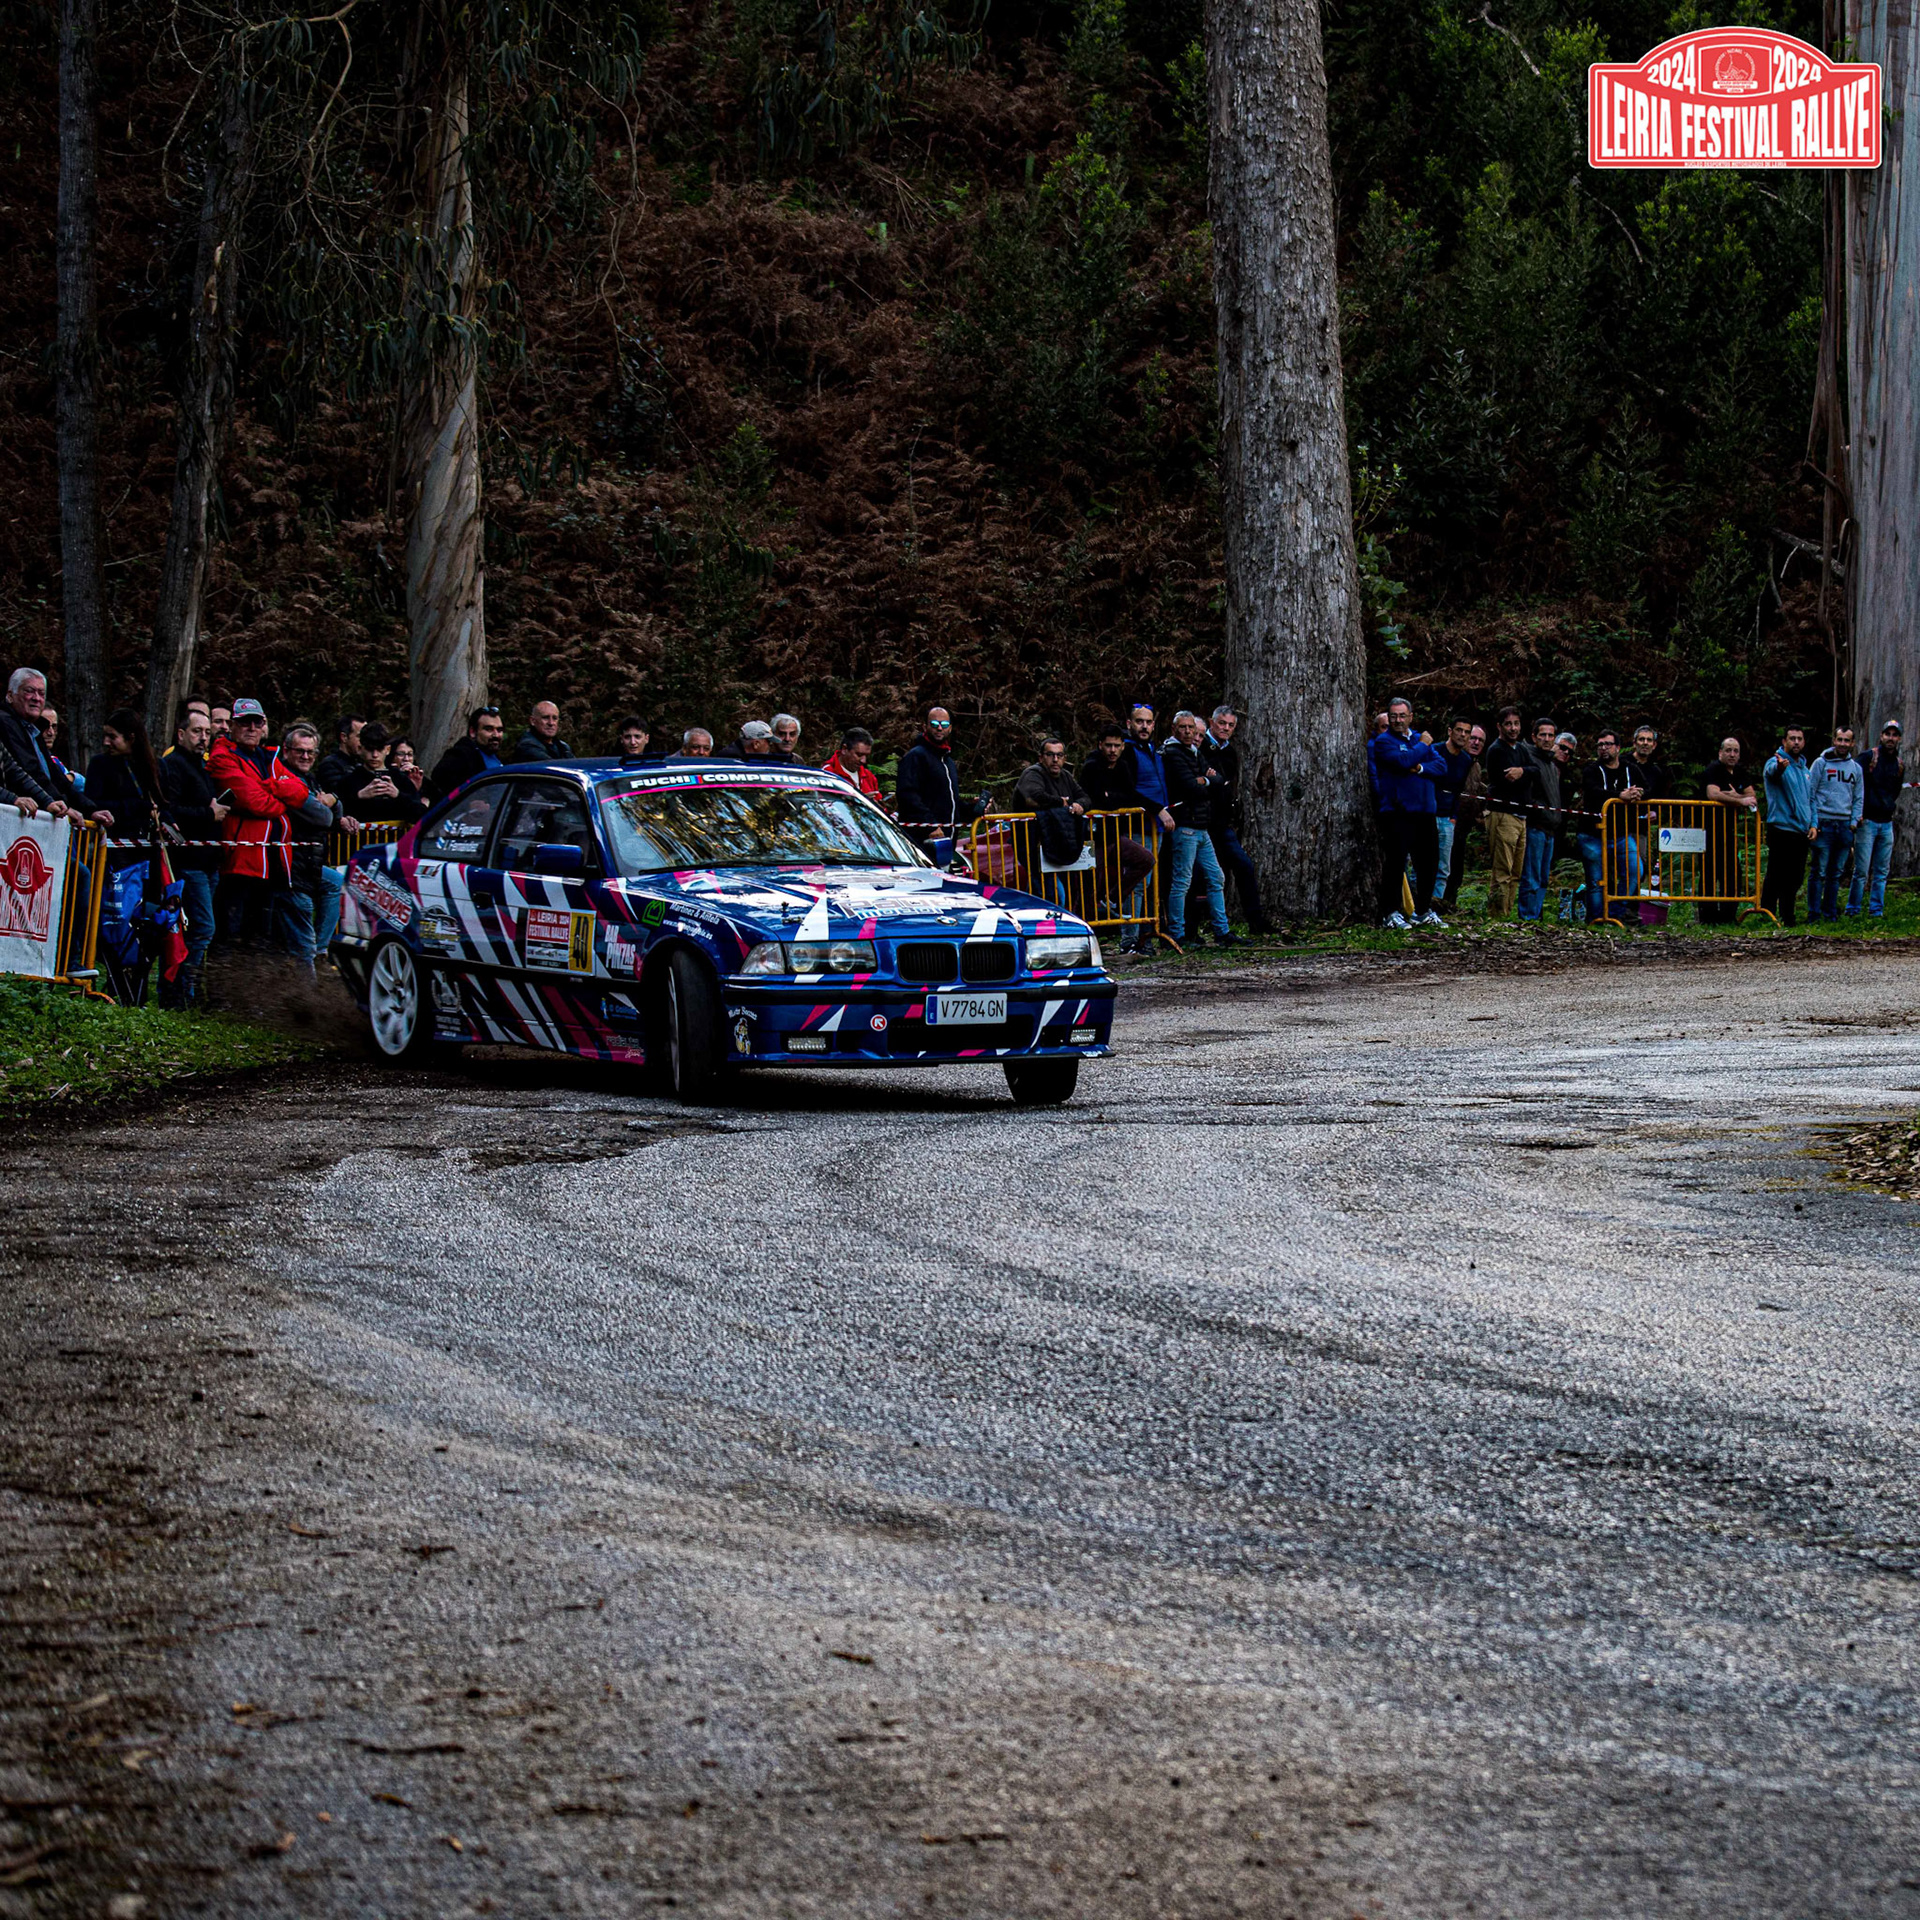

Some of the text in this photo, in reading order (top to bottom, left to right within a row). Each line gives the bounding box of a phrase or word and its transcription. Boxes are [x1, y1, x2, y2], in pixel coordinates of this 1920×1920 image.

[630, 773, 834, 789] FUCHI COMPETICIÓN
[1827, 769, 1856, 785] FILA
[537, 911, 558, 924] LEIRIA
[529, 924, 569, 940] FESTIVAL RALLYE
[605, 924, 620, 943] BAR
[573, 916, 589, 969] 40
[606, 942, 636, 970] PINZAS
